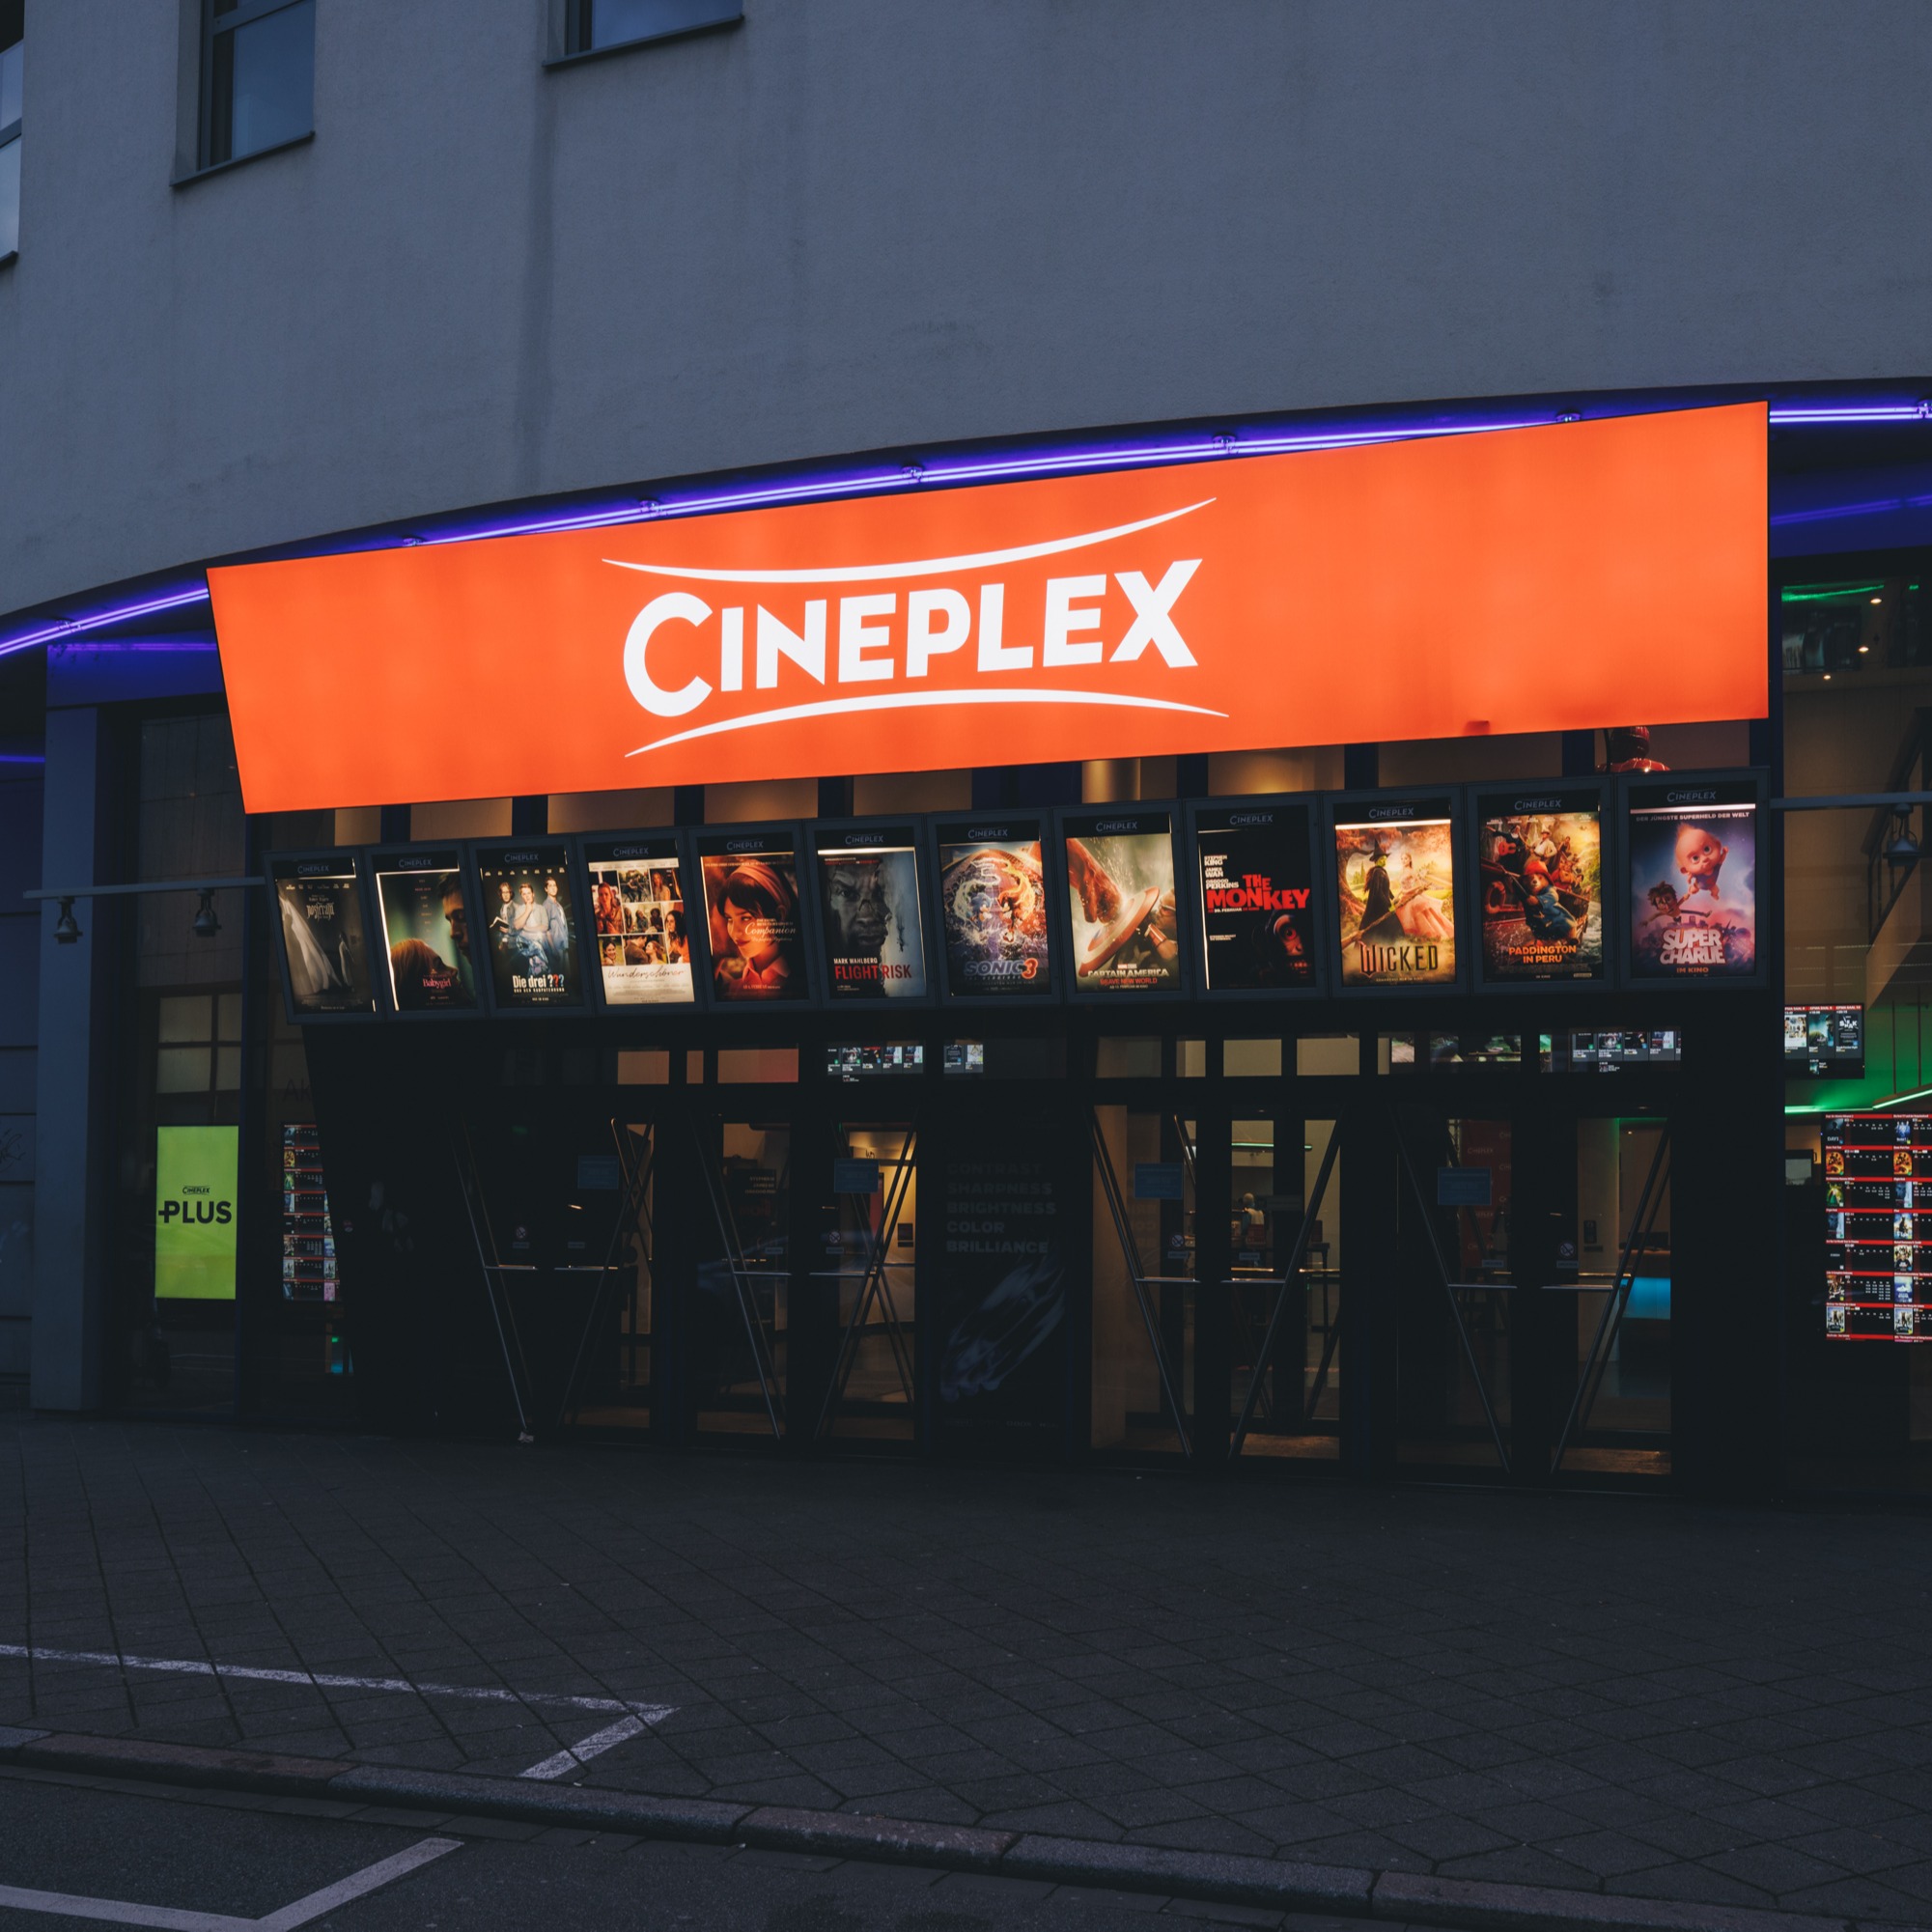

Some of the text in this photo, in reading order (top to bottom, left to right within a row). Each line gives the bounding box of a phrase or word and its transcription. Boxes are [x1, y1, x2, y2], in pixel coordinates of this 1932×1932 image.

[624, 559, 1203, 717] CINEPLEX
[1666, 792, 1717, 803] CINEPLEX
[1515, 799, 1561, 811] CINEPLEX
[1368, 807, 1414, 820] CINEPLEX
[1650, 813, 1678, 822] JÜNGSTE
[1679, 812, 1717, 821] SUPERHELD
[1229, 814, 1274, 826] CINEPLEX
[1096, 822, 1137, 832] CINEPLEX
[967, 828, 1008, 839] CINEPLEX
[726, 841, 764, 851] CINEPLEX
[845, 835, 884, 845] CINEPLEX
[504, 854, 539, 863] CINEPLEX
[613, 848, 649, 857] CINEPLEX
[399, 858, 433, 868] CINEPLEX
[1242, 874, 1273, 890] THE
[1206, 887, 1310, 910] MONKEY
[744, 922, 796, 938] Companion
[1663, 928, 1722, 950] SUPER
[1508, 945, 1577, 956] PADDINGTON
[1660, 945, 1726, 965] CHARLIE
[1358, 940, 1439, 978] WICKED
[1535, 955, 1563, 964] PERU
[834, 965, 911, 980] FLIGHT RISK
[965, 957, 1039, 980] SONIC 3
[1126, 967, 1170, 977] AMERICA
[423, 978, 452, 990] Babygirl
[513, 973, 565, 989] Die drei ???
[1468, 1146, 1494, 1155] CINEPLEX
[947, 1162, 1042, 1175] CONTRAST
[182, 1186, 210, 1196] CINEPLEX
[947, 1182, 1053, 1196] SHARPNESS
[157, 1200, 233, 1224] PLUS
[946, 1201, 1057, 1216] BRIGHTNESS
[946, 1219, 1005, 1234] COLOR
[946, 1239, 1050, 1255] BRILLIANCE
